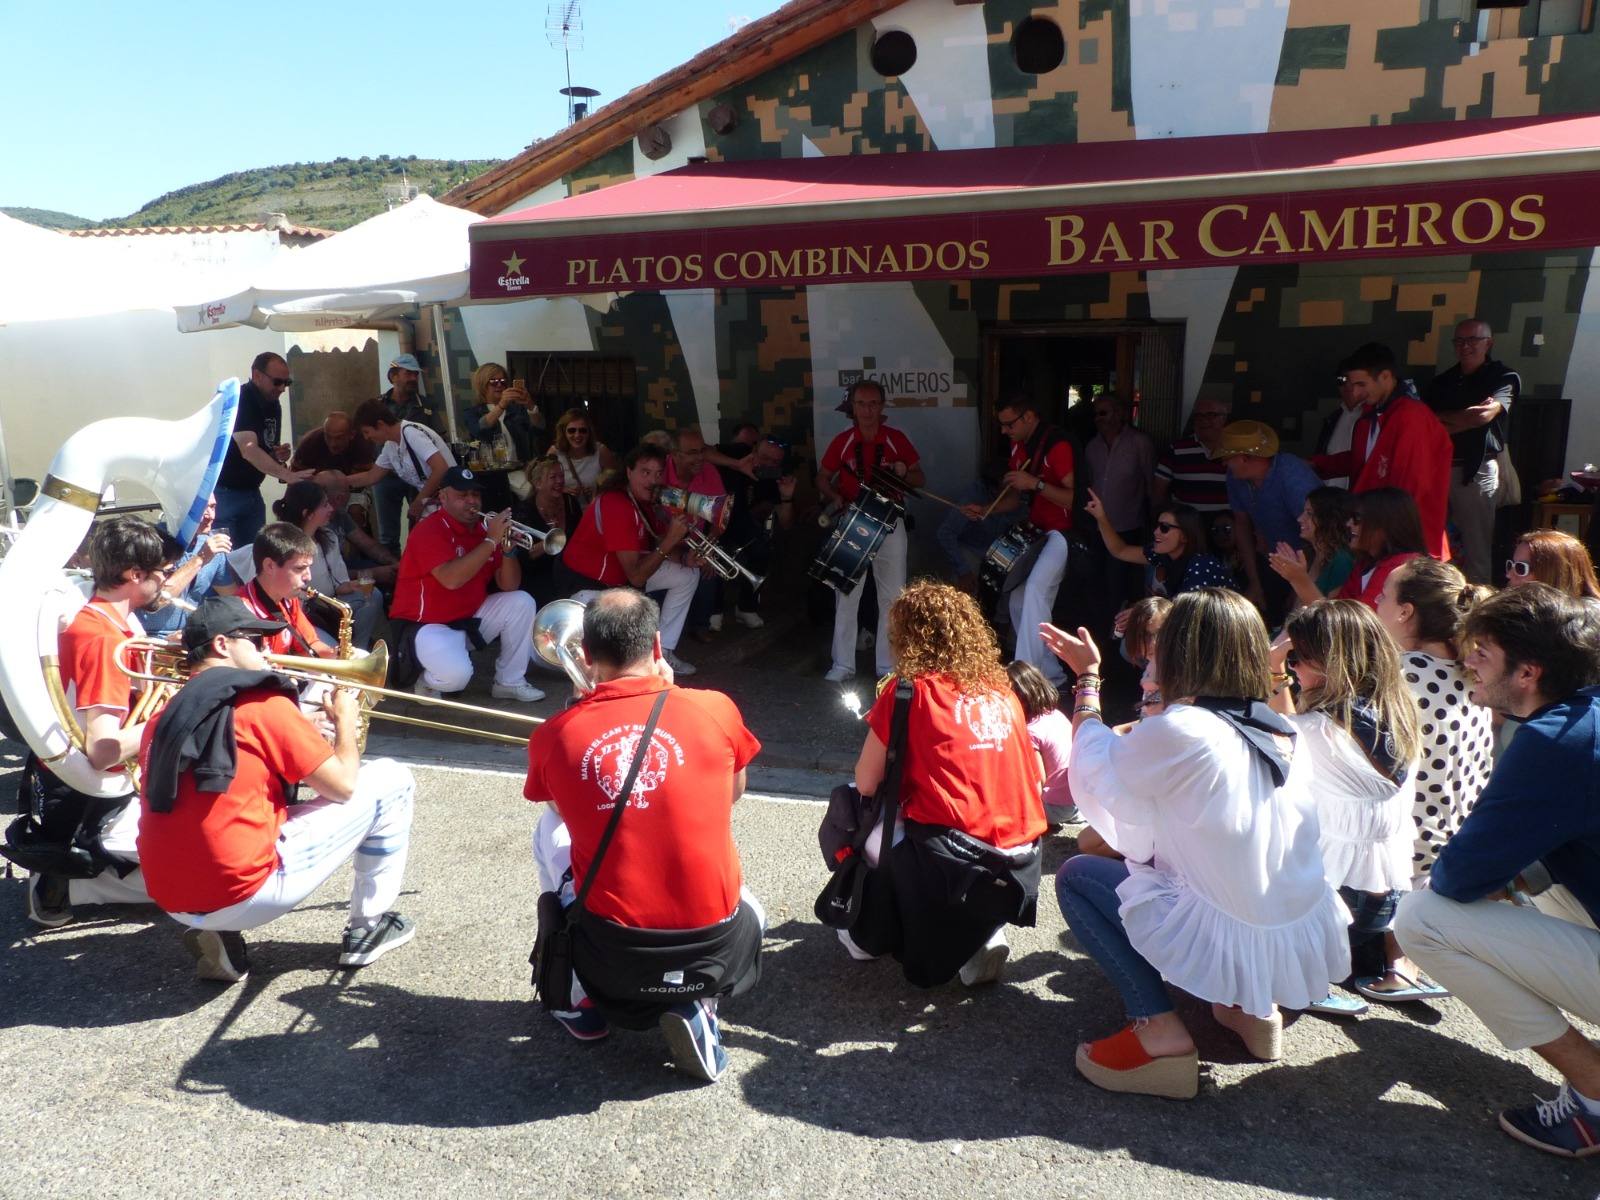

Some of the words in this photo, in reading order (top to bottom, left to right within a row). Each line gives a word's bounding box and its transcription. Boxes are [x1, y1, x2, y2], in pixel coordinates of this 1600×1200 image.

[1045, 214, 1180, 266] BAR
[1198, 194, 1546, 258] CAMEROS
[566, 254, 704, 286] PLATOS
[713, 240, 990, 280] COMBINADOS
[498, 276, 530, 287] Estrella
[653, 727, 676, 744] RUPO
[597, 800, 632, 810] LOGRO
[640, 982, 705, 993] LOGROÑO
